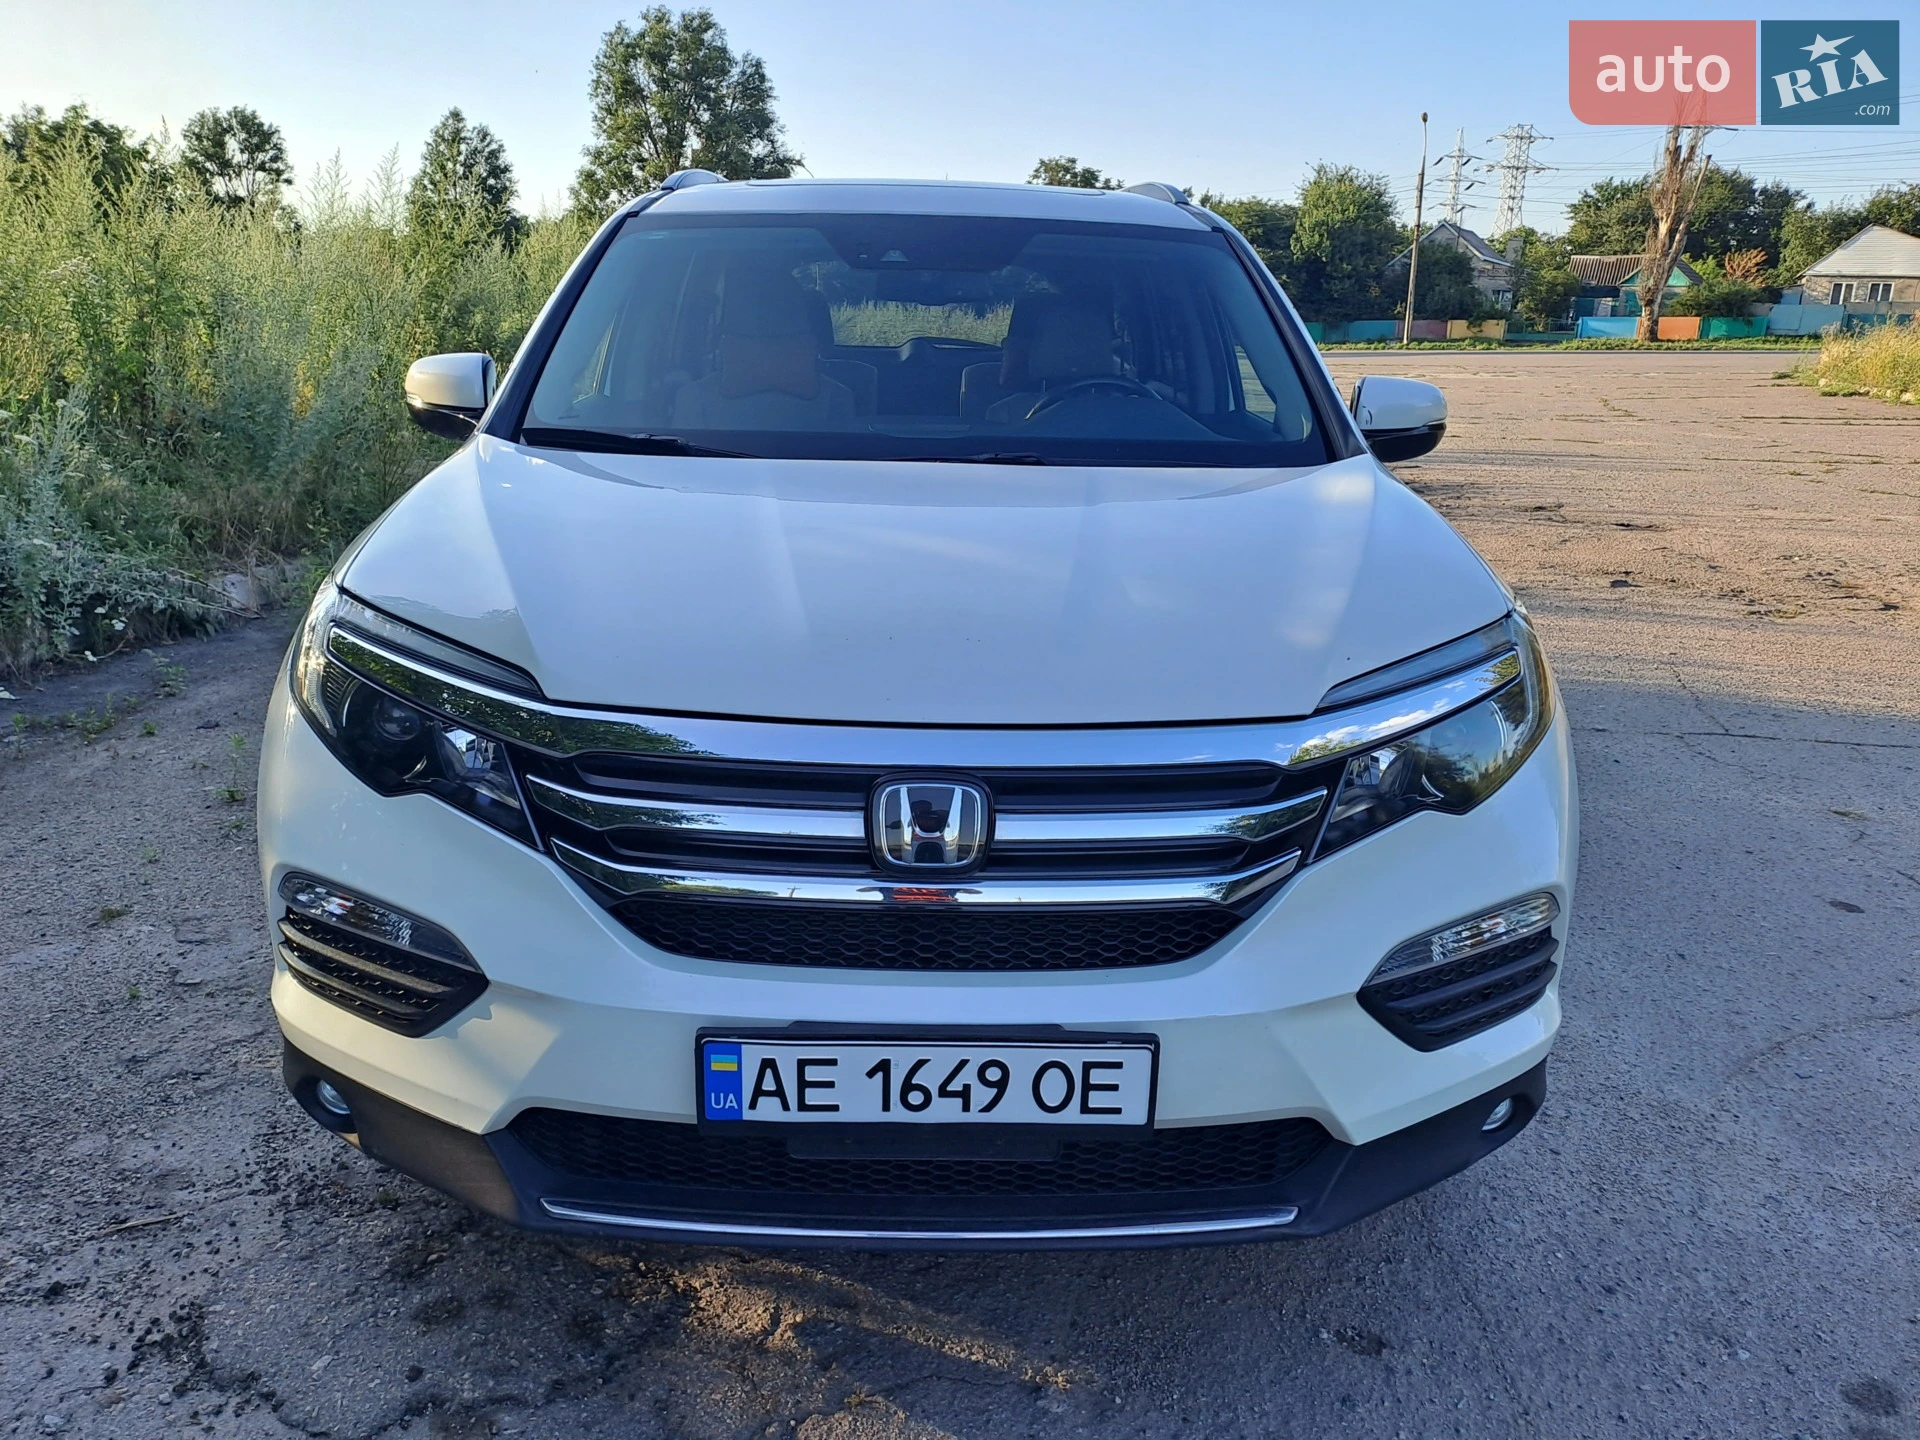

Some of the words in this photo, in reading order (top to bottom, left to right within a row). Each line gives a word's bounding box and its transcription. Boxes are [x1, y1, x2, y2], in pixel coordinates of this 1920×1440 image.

[711, 1092, 739, 1110] UA
[748, 1057, 840, 1112] AE
[865, 1058, 1011, 1113] 1649
[1031, 1060, 1124, 1115] OE
